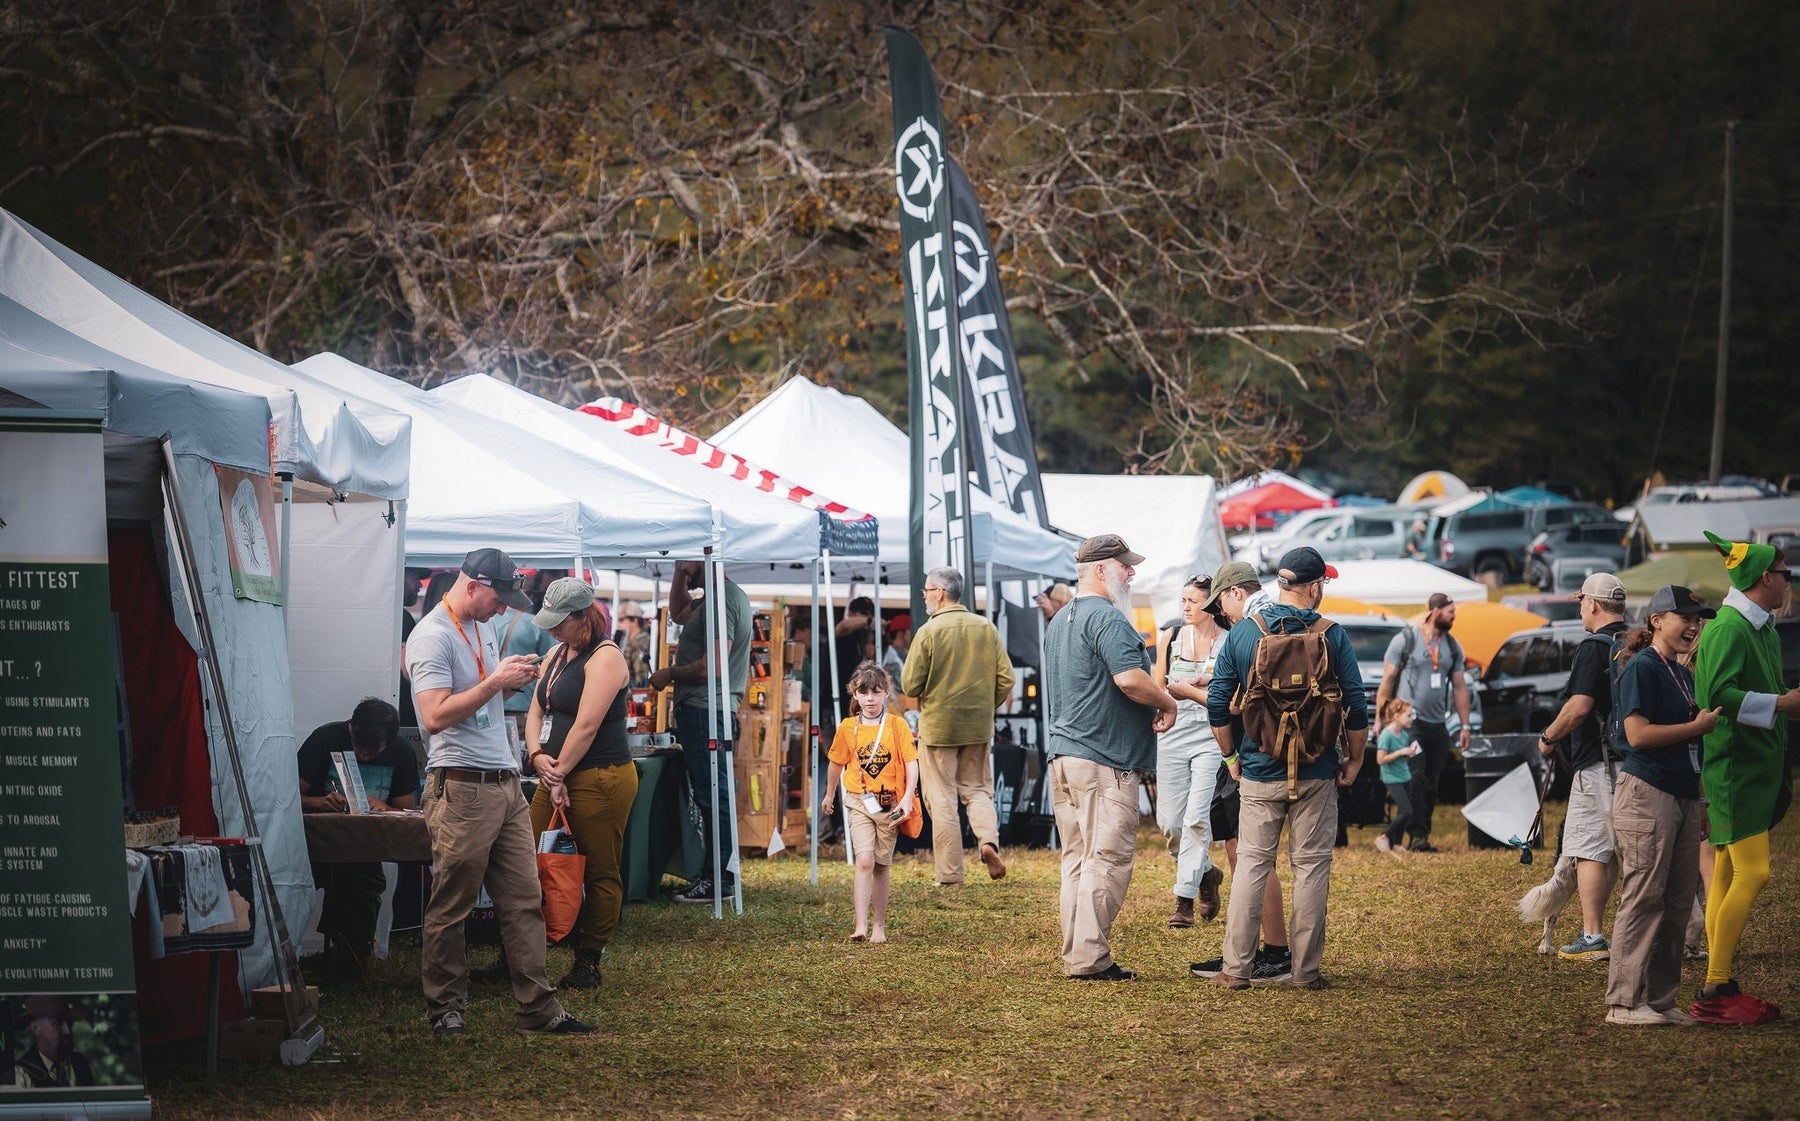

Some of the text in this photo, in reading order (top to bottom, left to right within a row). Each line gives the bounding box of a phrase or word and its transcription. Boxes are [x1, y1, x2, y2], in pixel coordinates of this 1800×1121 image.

[8, 571, 80, 588] FITTEST
[30, 600, 41, 610] OF
[9, 620, 70, 631] ENTHUSIASTS
[5, 696, 90, 708] USING STIMULANTS
[1, 726, 82, 737] OTEINS AND FATS
[5, 755, 78, 767] MUSCLE MEMORY
[5, 785, 63, 796] NITRIC OXIDE
[7, 814, 20, 825] TO
[23, 815, 61, 826] AROUSAL
[4, 846, 58, 858] INNATE AND
[7, 859, 43, 870] SYSTEM
[0, 893, 91, 904] OF FATIGUE CAUSING
[26, 906, 58, 918] WASTE
[61, 906, 108, 917] PRODUCTS
[4, 967, 114, 979] EVOLUTIONARY TESTING
